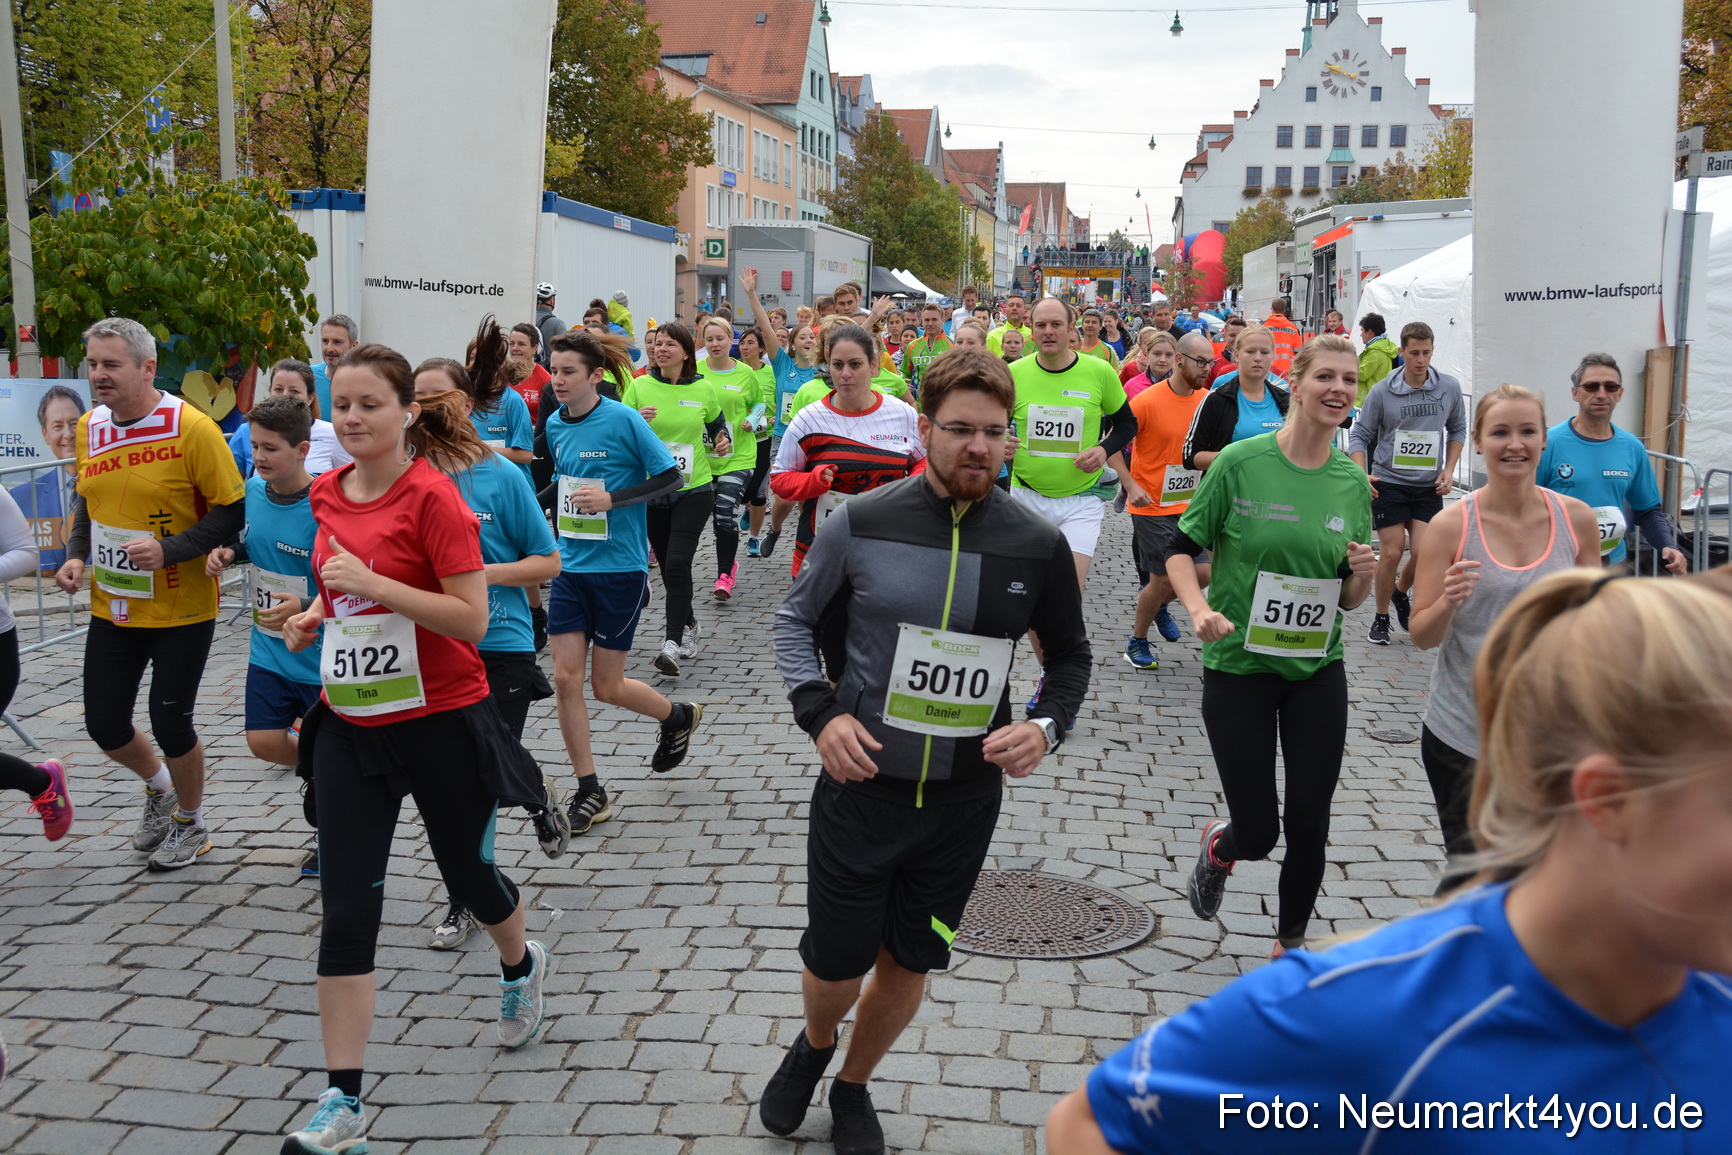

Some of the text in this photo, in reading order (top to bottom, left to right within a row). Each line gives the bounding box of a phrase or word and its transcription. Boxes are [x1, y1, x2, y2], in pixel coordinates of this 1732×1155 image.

[708, 241, 723, 256] D
[364, 275, 504, 297] www.bmw-laufsport.de
[1035, 420, 1075, 438] 5210
[1400, 442, 1432, 455] 5227
[85, 446, 182, 479] MAX BÖGL
[1168, 476, 1195, 491] 5226
[276, 541, 310, 558] BOCK
[105, 572, 133, 586] Christian
[1290, 585, 1320, 594] BOCK
[1263, 598, 1326, 628] 5162
[348, 623, 381, 634] BOCK
[1275, 632, 1306, 644] Monika
[943, 641, 981, 654] BOCK
[333, 644, 402, 679] 5122
[907, 659, 990, 700] 5010
[355, 688, 378, 700] Tina
[925, 704, 962, 720] Daniel
